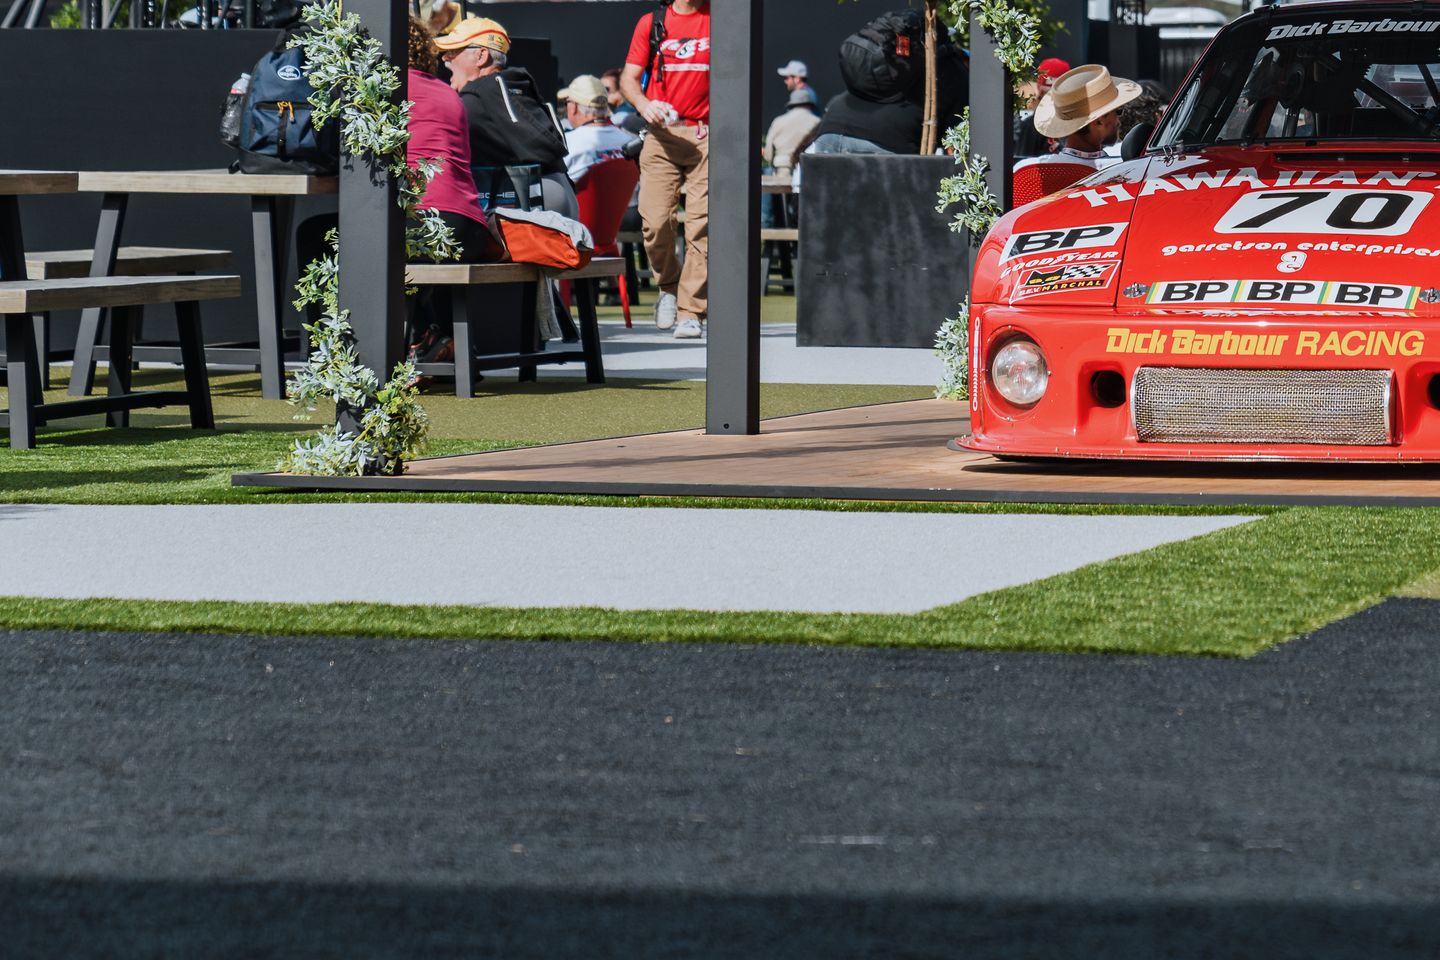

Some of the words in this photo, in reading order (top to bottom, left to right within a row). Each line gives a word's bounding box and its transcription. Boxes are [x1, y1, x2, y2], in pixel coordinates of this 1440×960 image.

[1265, 22, 1328, 40] Dick
[1067, 167, 1436, 207] HAWAIIAN
[1232, 191, 1414, 230] 70
[1008, 225, 1115, 258] BP
[1161, 240, 1286, 256] garretson
[1000, 250, 1119, 279] GOODYEAR
[1042, 279, 1102, 291] MARCHAL
[1161, 281, 1229, 302] BP
[1247, 281, 1316, 302] BP
[1335, 283, 1403, 306] BP
[1106, 327, 1167, 353] Dick
[1170, 329, 1289, 355] Barbour
[1296, 330, 1425, 356] RACING
